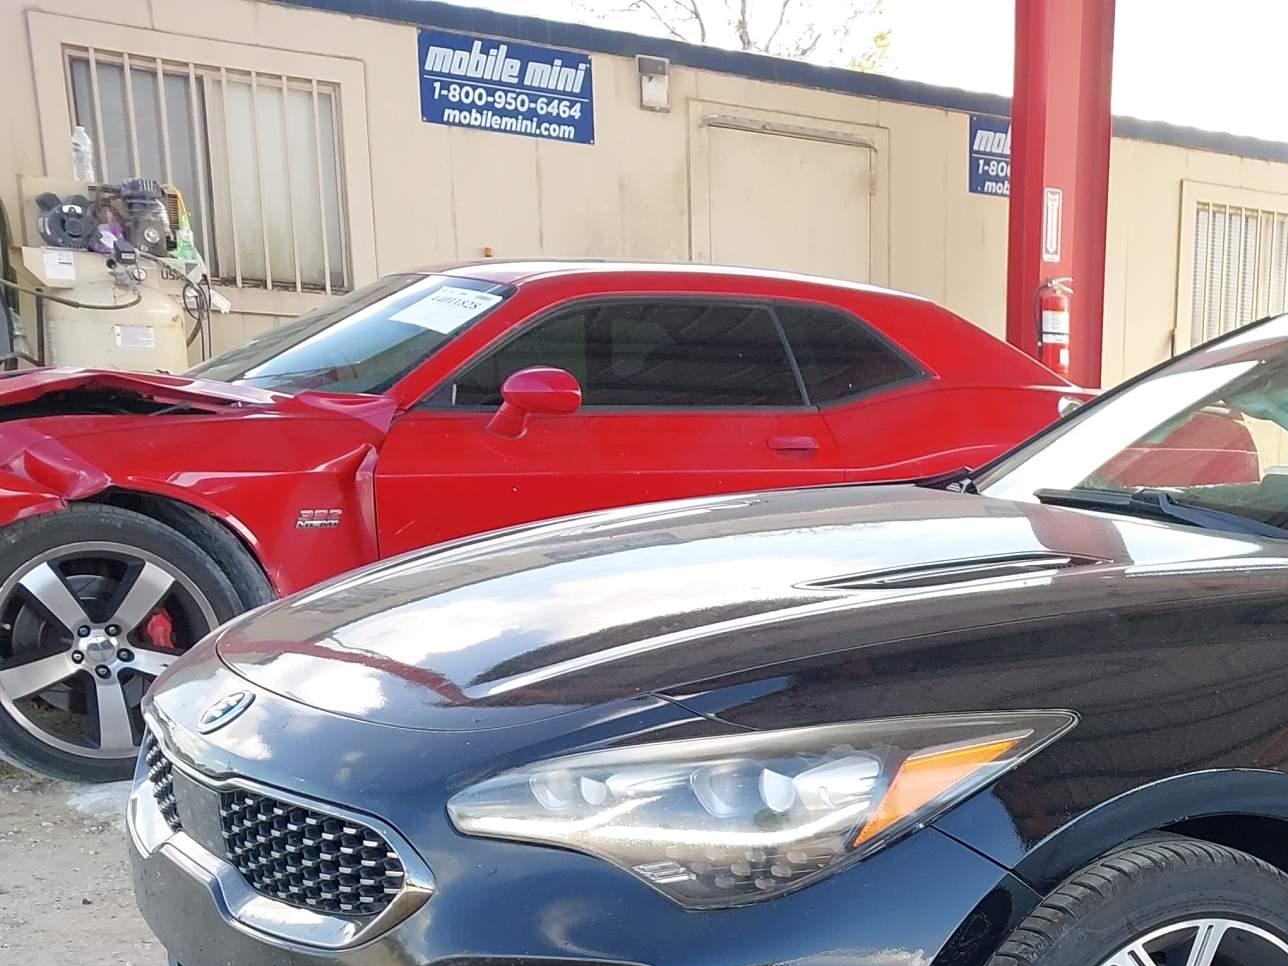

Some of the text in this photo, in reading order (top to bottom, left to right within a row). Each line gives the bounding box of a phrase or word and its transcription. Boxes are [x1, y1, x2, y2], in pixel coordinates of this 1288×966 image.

[424, 39, 587, 93] mobile mini
[432, 81, 582, 120] 1-800-950-6464
[443, 108, 575, 139] mobilemini.com
